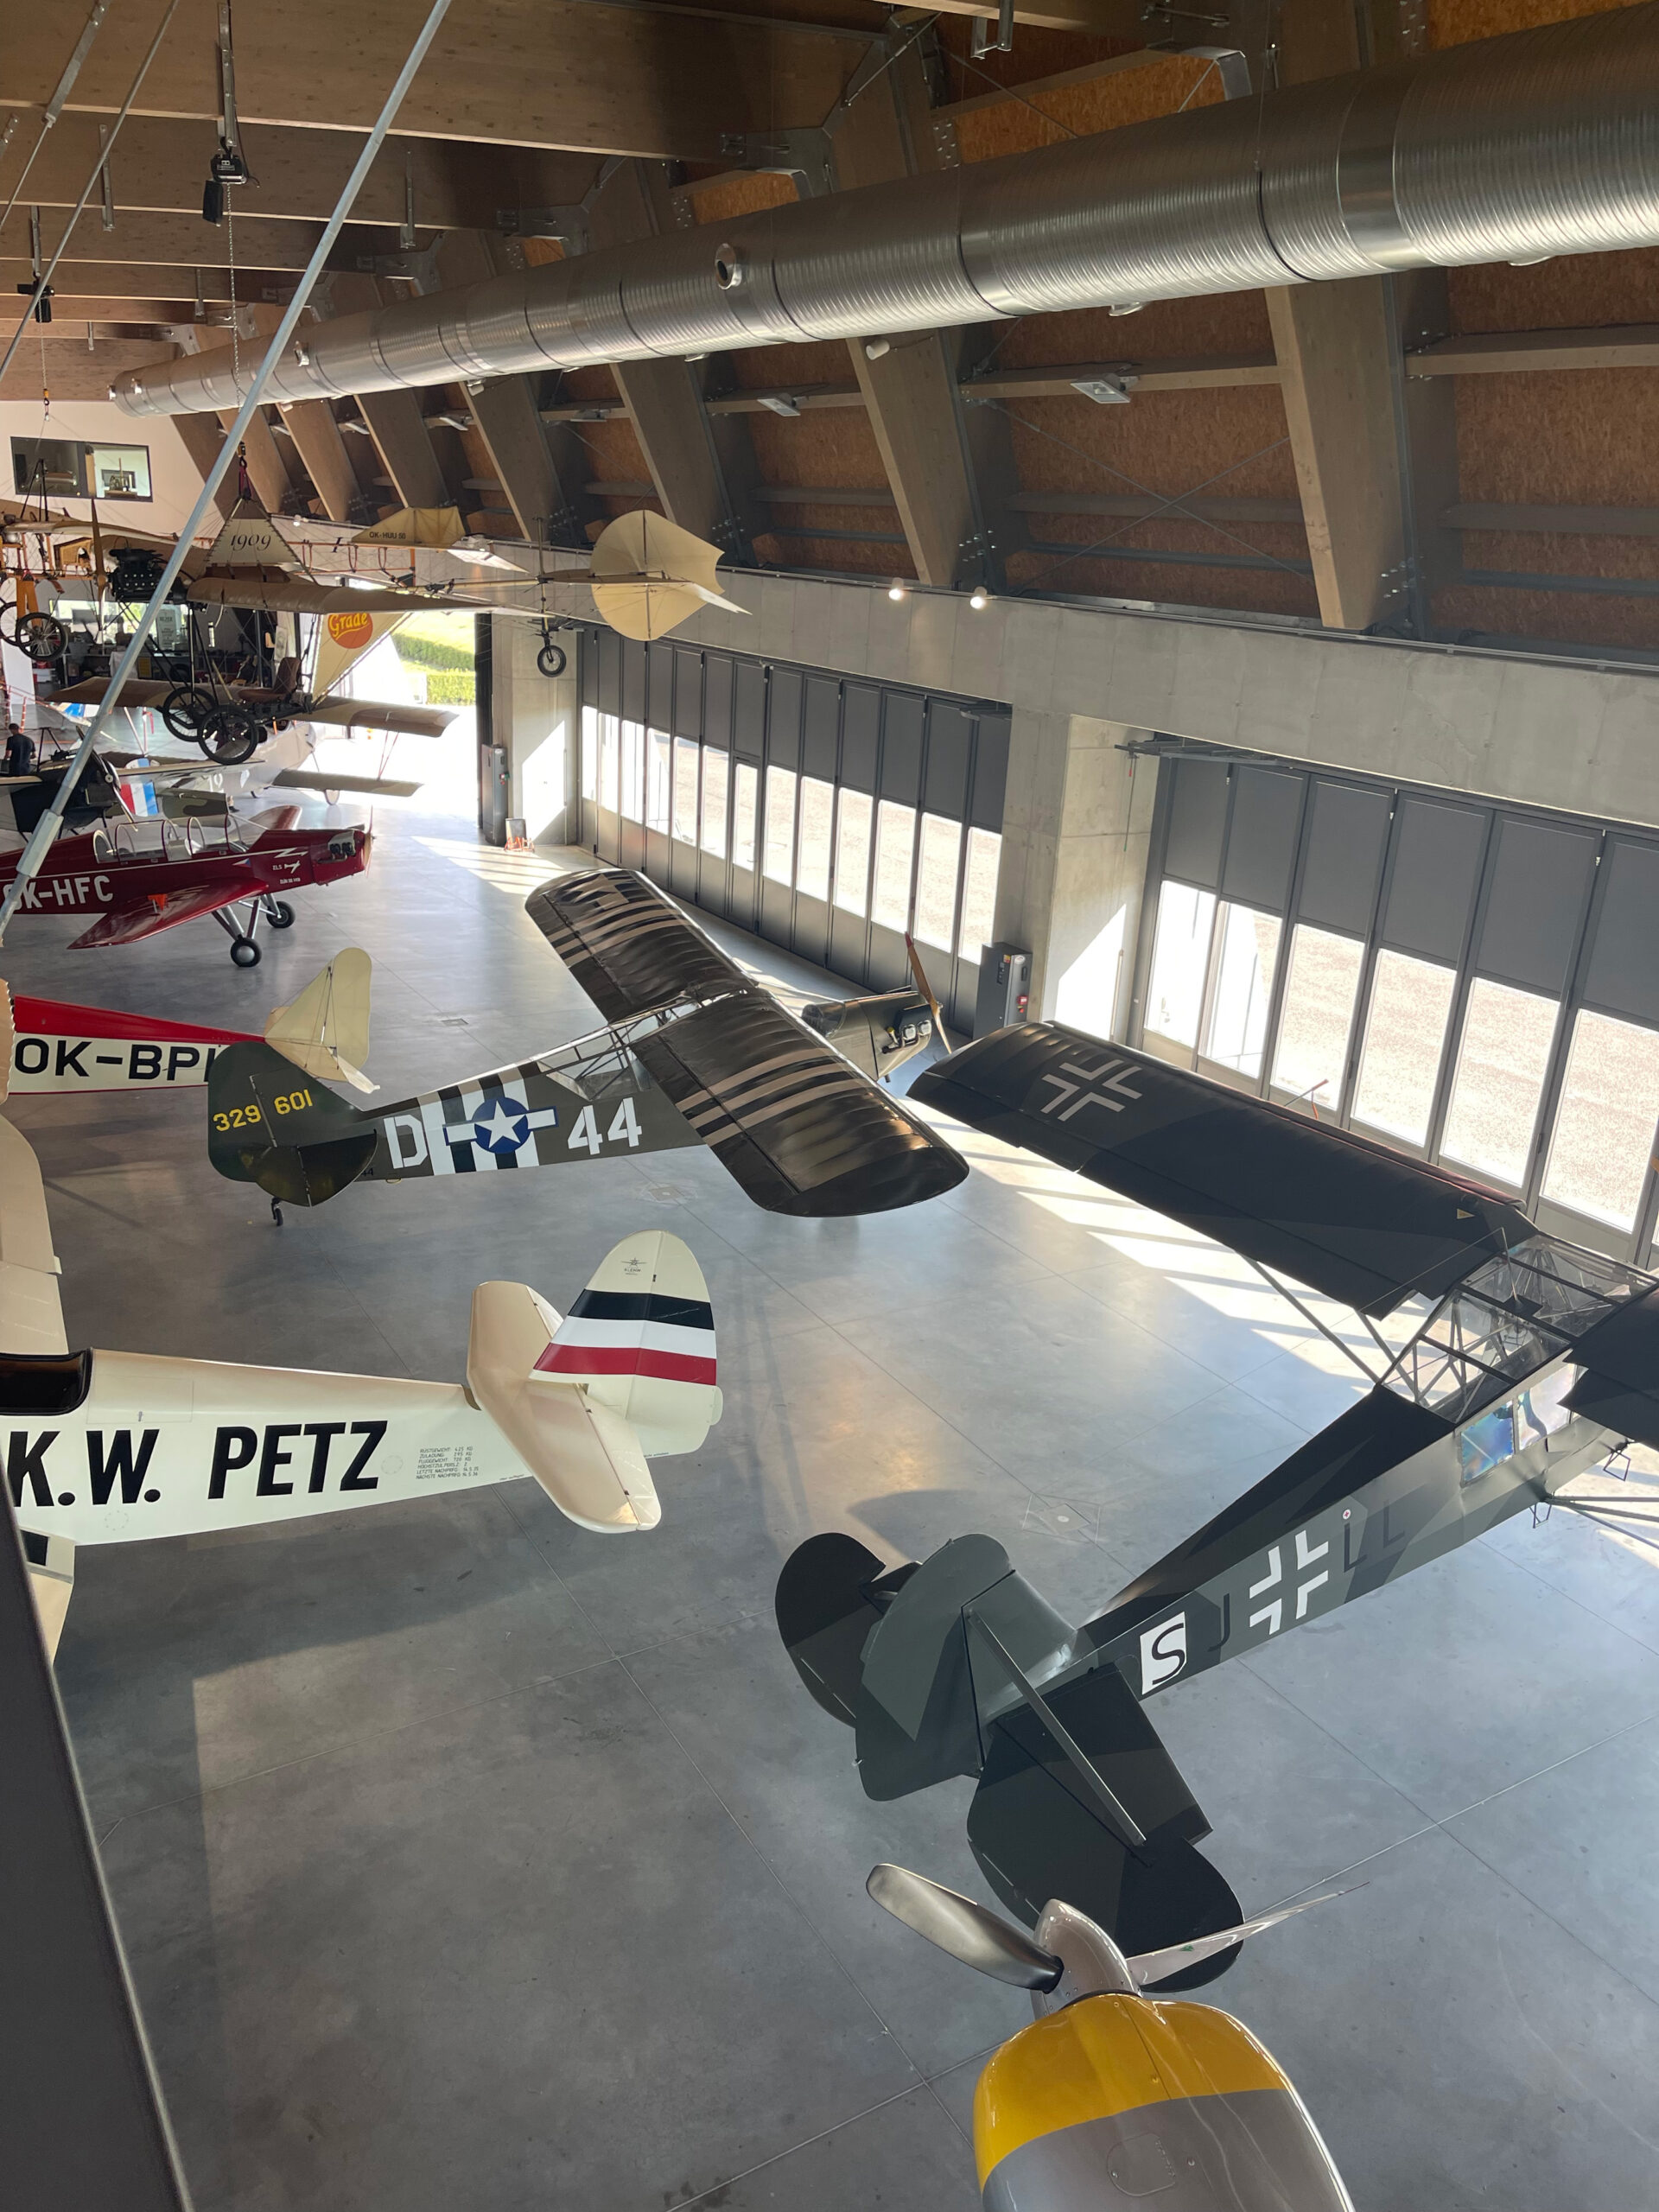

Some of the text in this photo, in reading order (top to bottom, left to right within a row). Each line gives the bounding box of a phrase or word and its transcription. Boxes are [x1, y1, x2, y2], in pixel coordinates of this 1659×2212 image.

[230, 533, 272, 552] 1909
[328, 612, 368, 637] Grade
[213, 1089, 313, 1132] 329 601
[383, 1096, 643, 1169] D 44
[207, 1420, 389, 1500] PETZ
